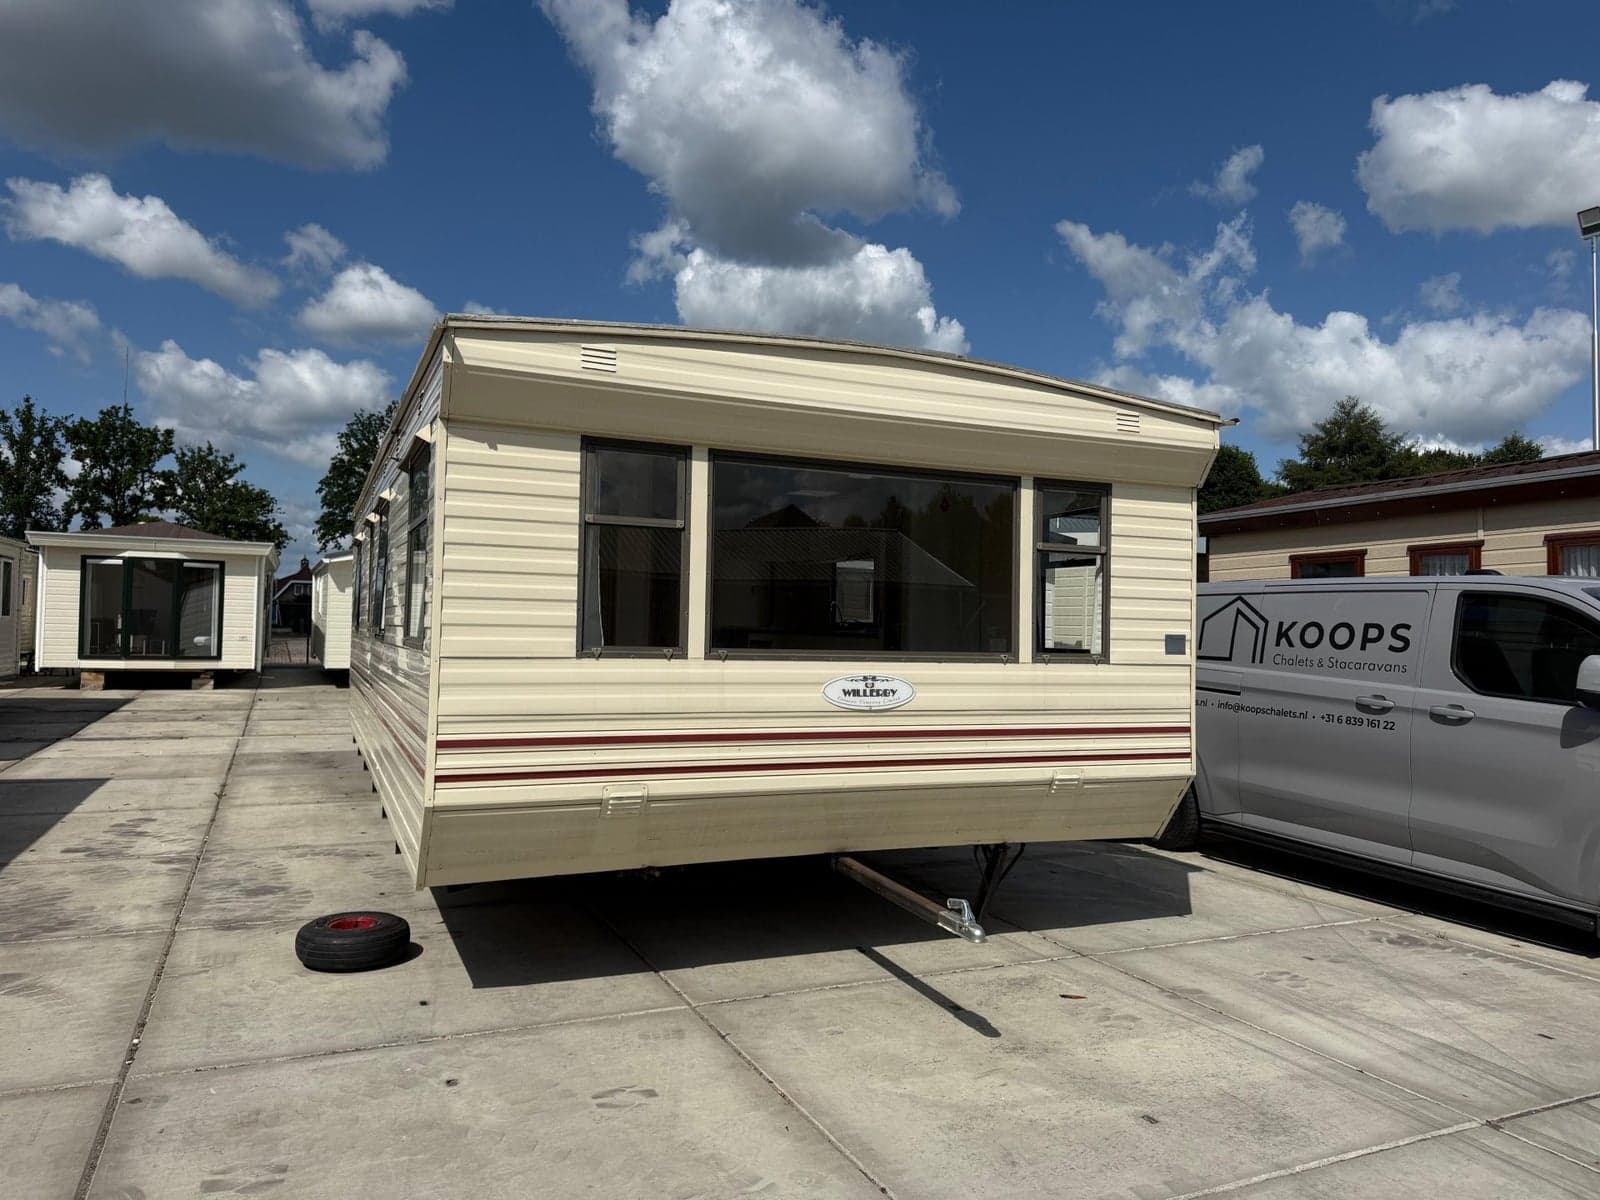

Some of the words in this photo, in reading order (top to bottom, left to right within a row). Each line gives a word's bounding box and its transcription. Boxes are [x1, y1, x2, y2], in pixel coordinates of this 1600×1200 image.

[1275, 621, 1412, 653] KOOPS
[1273, 653, 1314, 668] Chalets
[1317, 660, 1325, 668] &
[1327, 657, 1408, 674] Stacaravans
[842, 688, 898, 698] WILLERBY
[1217, 700, 1308, 720] info@koopschalets.nl
[1320, 713, 1335, 724] +31
[1336, 715, 1344, 725] 6
[1345, 716, 1364, 727] 839
[1366, 718, 1381, 729] 161
[1382, 720, 1396, 731] 22
